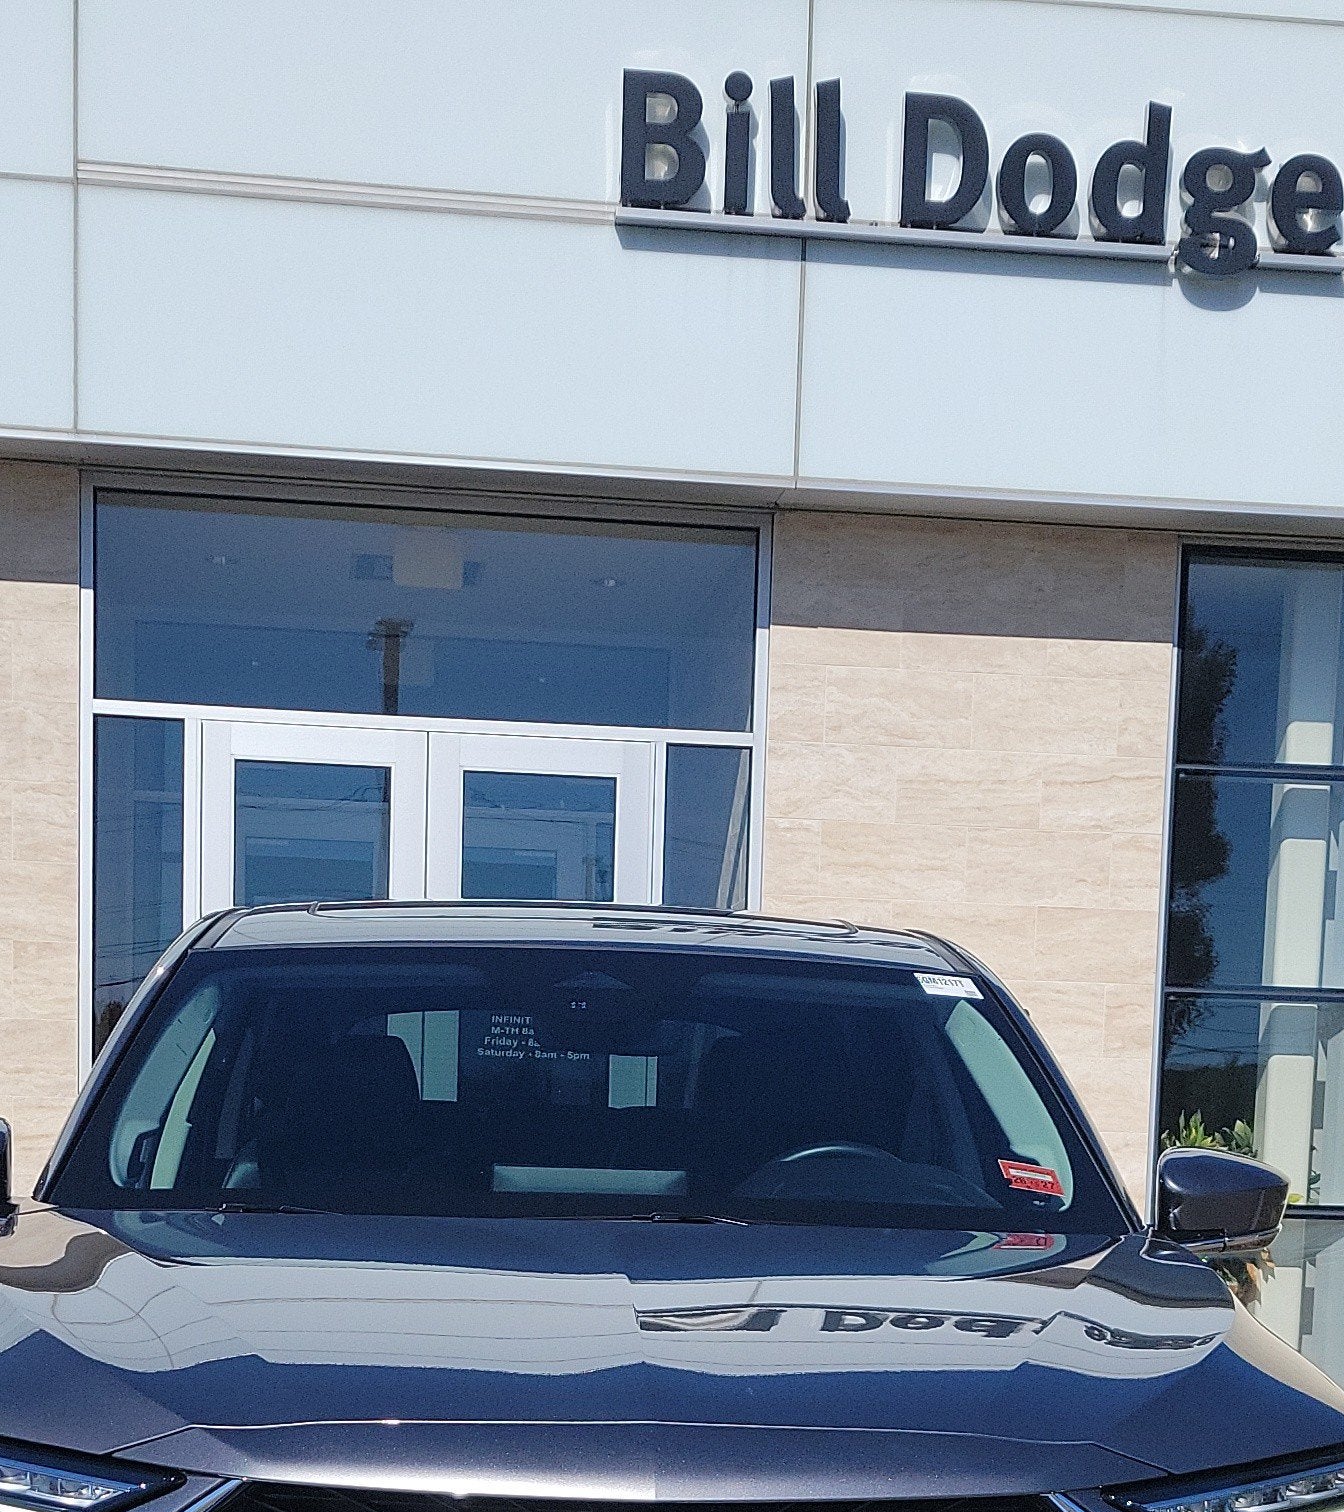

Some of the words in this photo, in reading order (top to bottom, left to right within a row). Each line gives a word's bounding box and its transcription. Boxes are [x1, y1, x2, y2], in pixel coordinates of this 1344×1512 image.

[621, 67, 851, 222] Bill
[900, 90, 1344, 276] Dodge
[491, 1015, 533, 1025] INFINIT
[484, 1036, 518, 1048] Friday
[477, 1047, 525, 1059] Saturday
